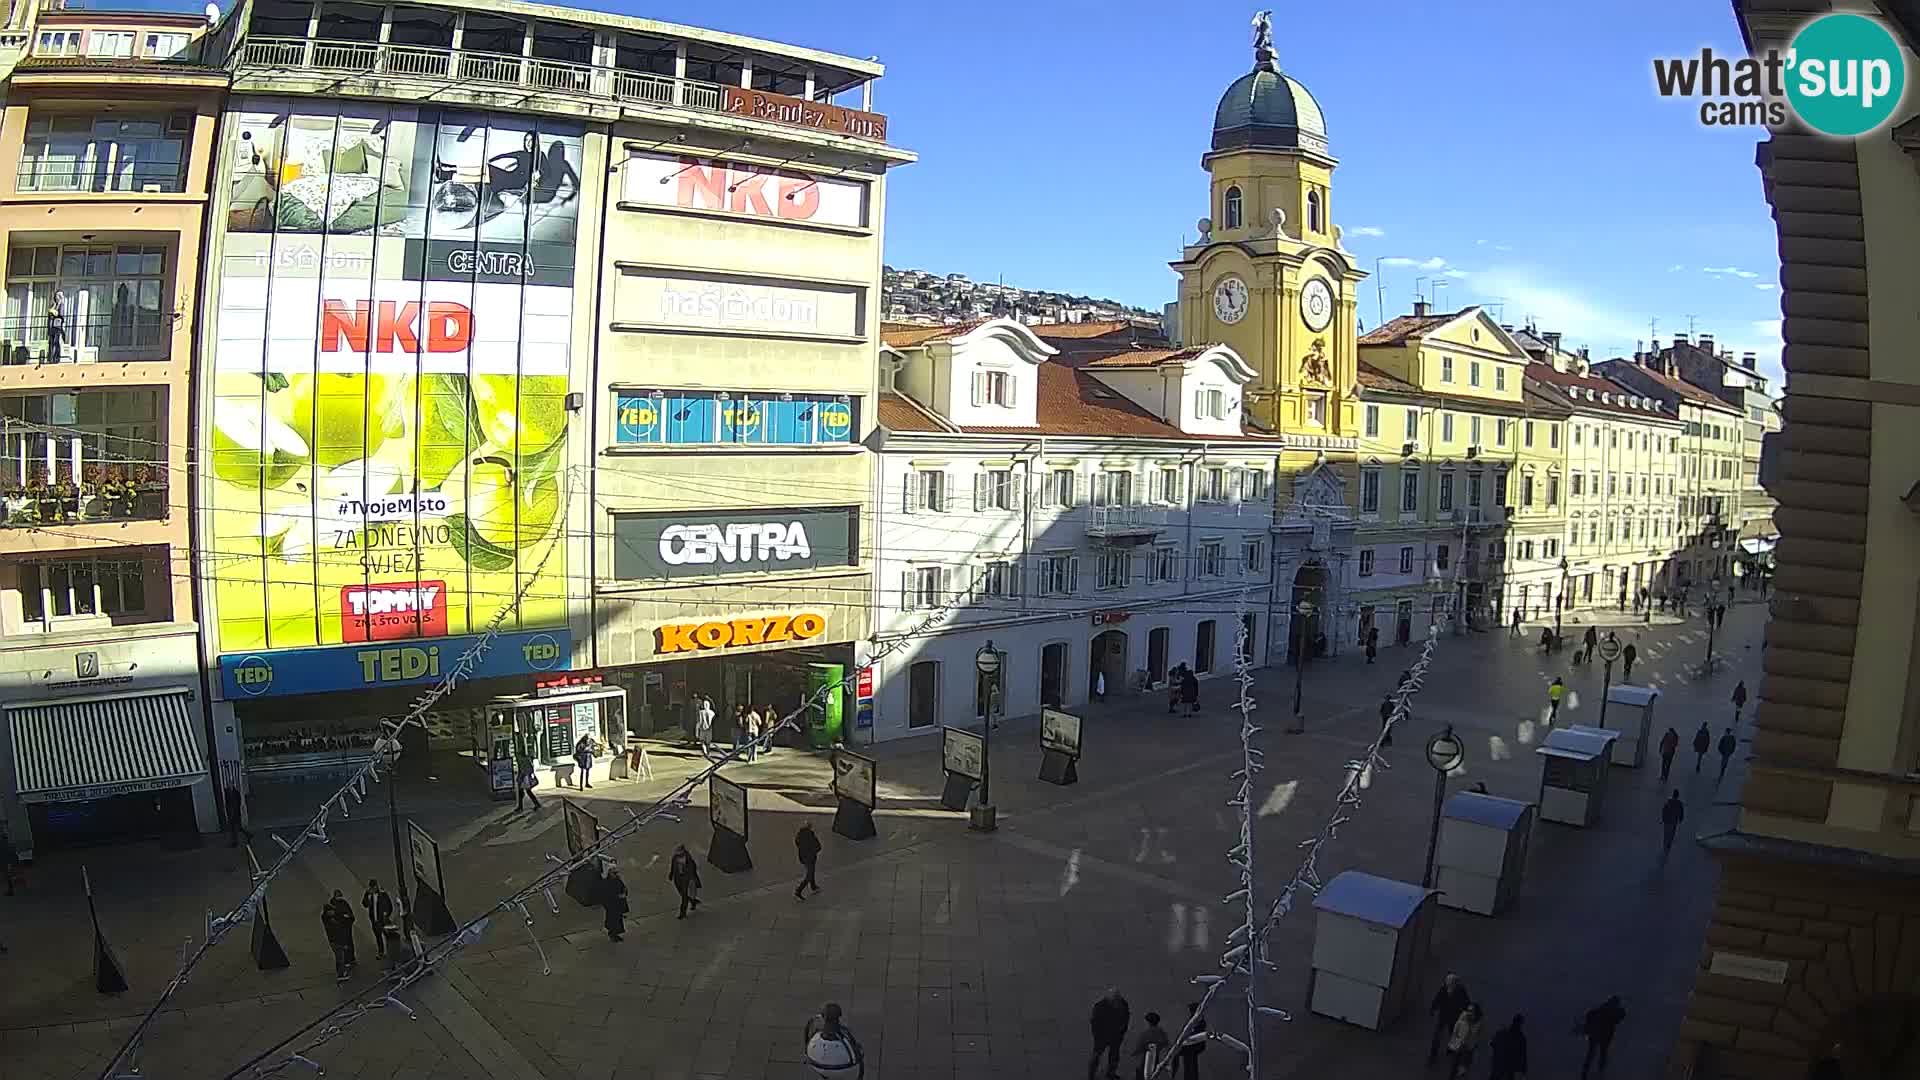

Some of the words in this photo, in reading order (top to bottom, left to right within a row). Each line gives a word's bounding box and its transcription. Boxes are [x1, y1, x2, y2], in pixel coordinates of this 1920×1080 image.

[722, 88, 745, 113] Le
[676, 157, 820, 219] NKD
[448, 250, 535, 276] CENTRA
[321, 299, 475, 353] NKD
[333, 529, 358, 549] ZA
[366, 524, 450, 548] DNEVNO
[658, 520, 811, 565] CENTRA
[359, 548, 425, 576] SVJEŽE
[348, 586, 440, 616] TOMMY
[380, 614, 400, 626] ŠTO
[654, 613, 825, 655] KORZO
[358, 646, 440, 682] TEDi
[522, 643, 560, 661] TEDi
[233, 666, 273, 684] TEDi
